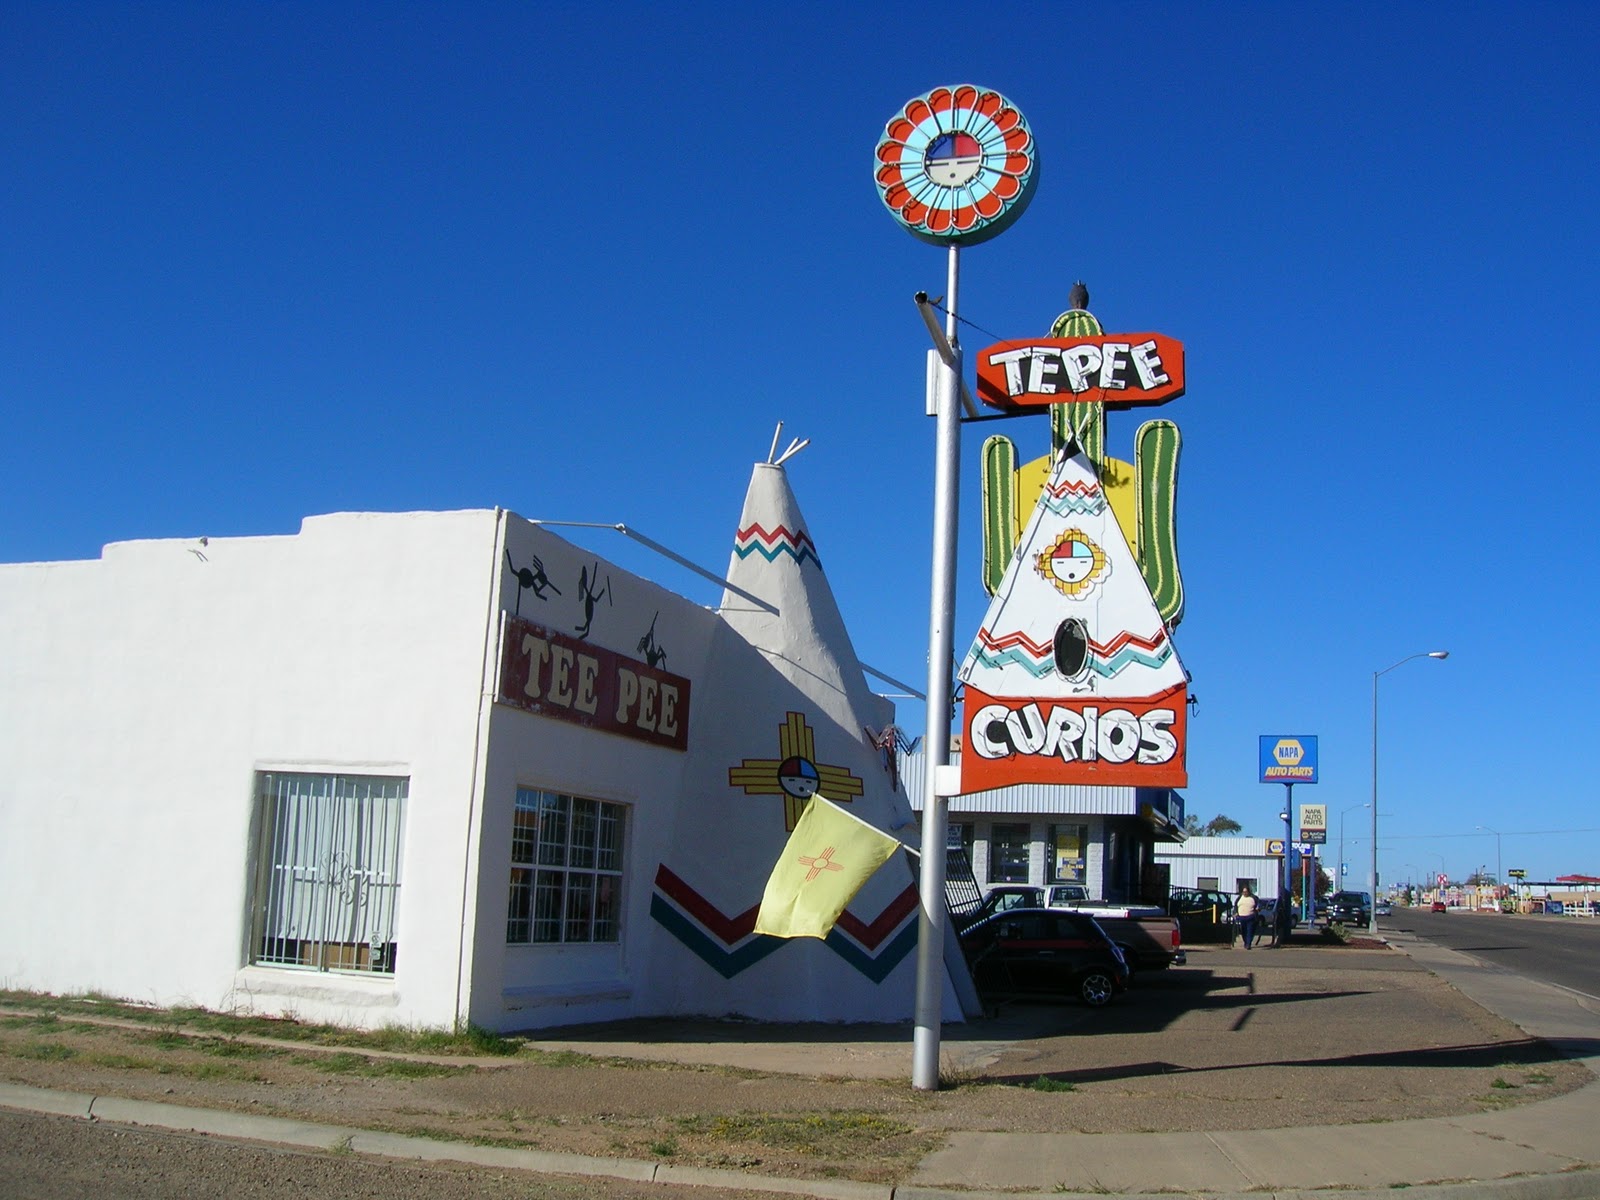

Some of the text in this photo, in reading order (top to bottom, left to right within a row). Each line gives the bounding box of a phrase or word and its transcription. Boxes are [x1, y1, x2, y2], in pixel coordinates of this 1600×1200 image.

[989, 340, 1169, 397] TEPEE
[521, 633, 679, 738] TEE PEE
[970, 702, 1178, 764] CURIOS
[1278, 746, 1299, 758] NAPA
[1265, 766, 1313, 776] AUTO PARTS
